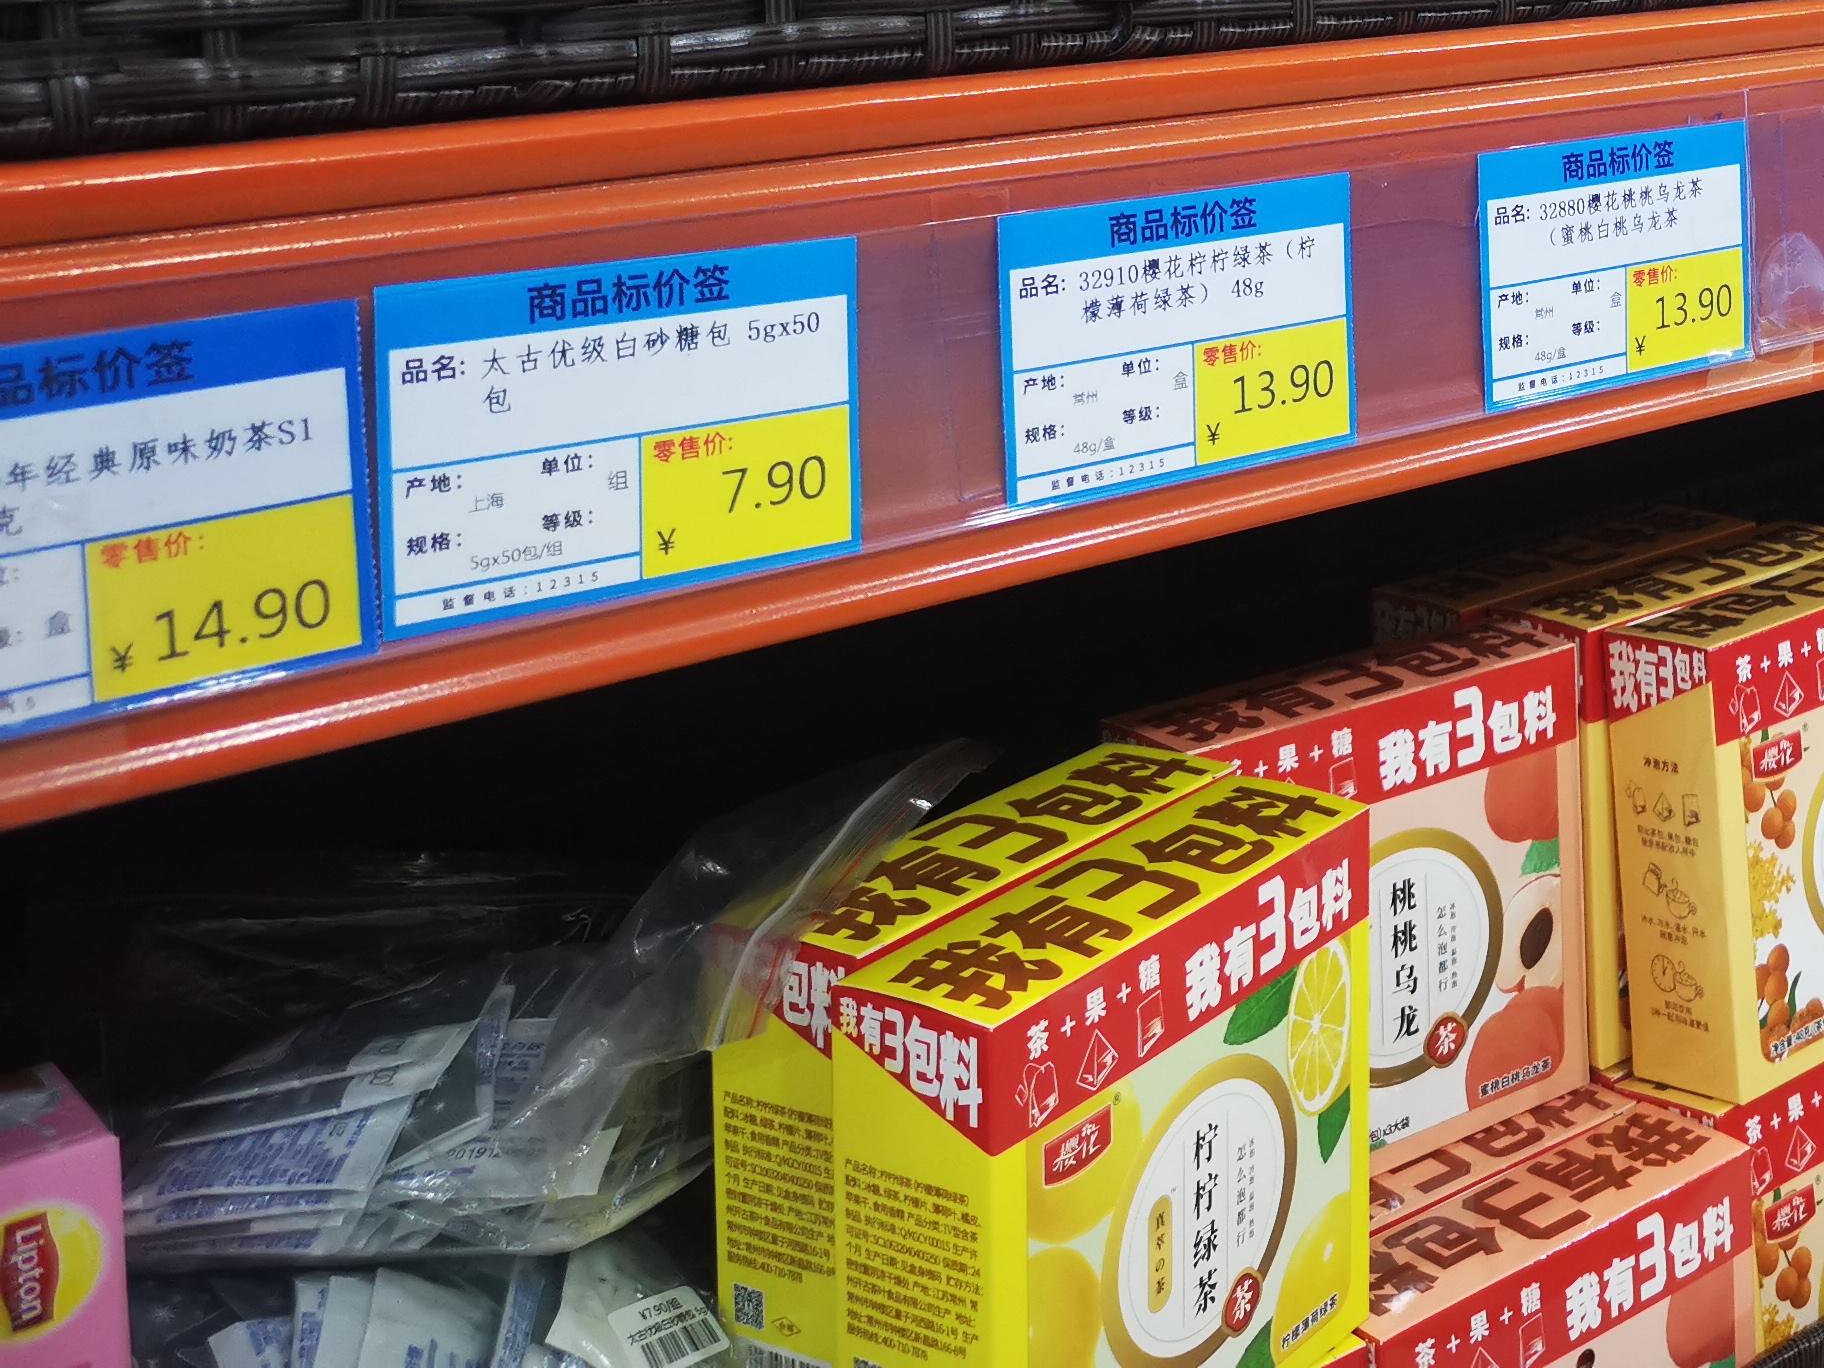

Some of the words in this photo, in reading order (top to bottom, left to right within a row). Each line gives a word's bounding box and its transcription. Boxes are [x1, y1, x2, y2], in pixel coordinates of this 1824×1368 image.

[1562, 140, 1674, 182] 商品标价签
[1494, 206, 1530, 225] 品名:
[1539, 177, 1704, 222] 32880樱花桃桃乌龙茶
[1108, 196, 1258, 248] 商品标价签
[527, 264, 730, 324] 商品标价签
[1019, 276, 1066, 300] 品名:
[1231, 278, 1264, 300] 48g
[1632, 266, 1678, 288] 零售价:
[1656, 284, 1732, 330] 13.90
[401, 357, 466, 385] 品名:
[482, 320, 732, 379] 太古优级白砂糖包
[747, 311, 821, 346] 5gx50
[1202, 342, 1263, 367] 零售价:
[1023, 376, 1065, 395] 产地:
[1121, 359, 1160, 378] 单位:
[1173, 371, 1189, 390] 盒
[1233, 360, 1335, 414] 13.90
[483, 387, 512, 414] 包
[1122, 406, 1161, 425] 等级:
[5, 416, 313, 493] 年经典原味奶茶S1
[652, 433, 734, 464] 零售价:
[1024, 424, 1065, 445] 规格:
[541, 452, 594, 477] 单位:
[608, 470, 629, 491] 组
[405, 472, 464, 498] 产地:
[469, 492, 505, 513] 上海
[722, 456, 826, 515] 7.90
[542, 509, 594, 533] 等级:
[100, 530, 205, 569] 零售价:
[405, 531, 463, 557] 规格:
[470, 540, 562, 571] 5gx50包/组
[155, 579, 330, 662] 14.90
[1608, 641, 1708, 712] 我有3包料
[1378, 685, 1558, 790] 我有3包料
[889, 784, 1342, 1011] 我有3包料
[1184, 858, 1354, 1022] 我有3包料
[1389, 877, 1421, 1043] 桃桃乌龙
[1433, 1020, 1457, 1055] 茶
[837, 992, 983, 1129] 我有3包料
[1478, 1058, 1553, 1099] 蜜桃白桃乌龙茶
[1190, 1121, 1221, 1316] 柠柠绿茶
[10, 1216, 44, 1326] Lipton
[1564, 1195, 1734, 1343] 我有3包料
[1230, 1276, 1256, 1316] 茶
[1279, 1292, 1339, 1352] 柠檬薄荷绿茶
